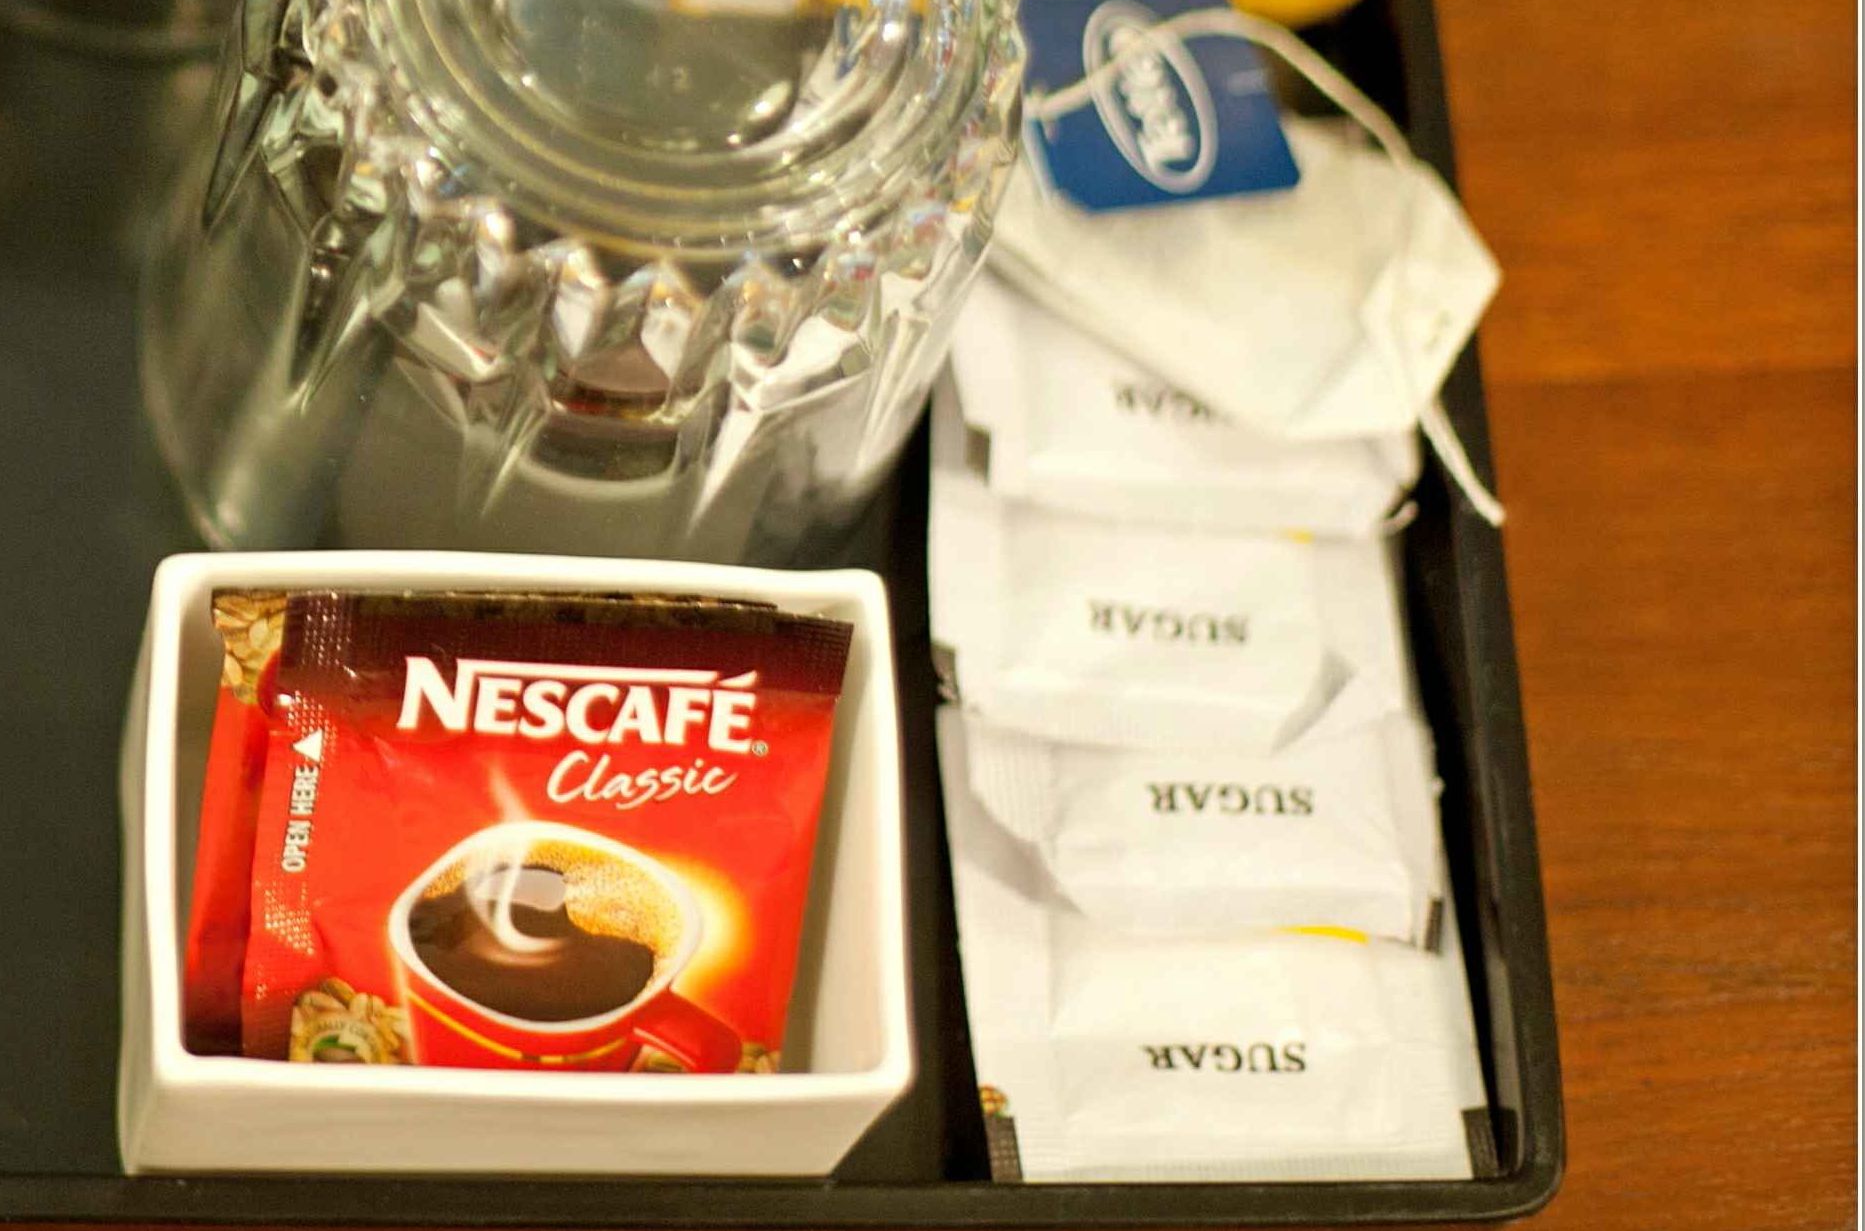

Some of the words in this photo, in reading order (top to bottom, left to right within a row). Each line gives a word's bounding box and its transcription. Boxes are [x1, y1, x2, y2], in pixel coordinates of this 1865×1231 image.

[1089, 604, 1248, 645] SUGAR
[395, 655, 757, 755] NESCAFÉ
[289, 765, 320, 816] HERE
[546, 749, 736, 810] Classic
[1148, 782, 1314, 817] SUGAR
[281, 819, 312, 873] OPEN
[1142, 1043, 1307, 1074] SUGAR
